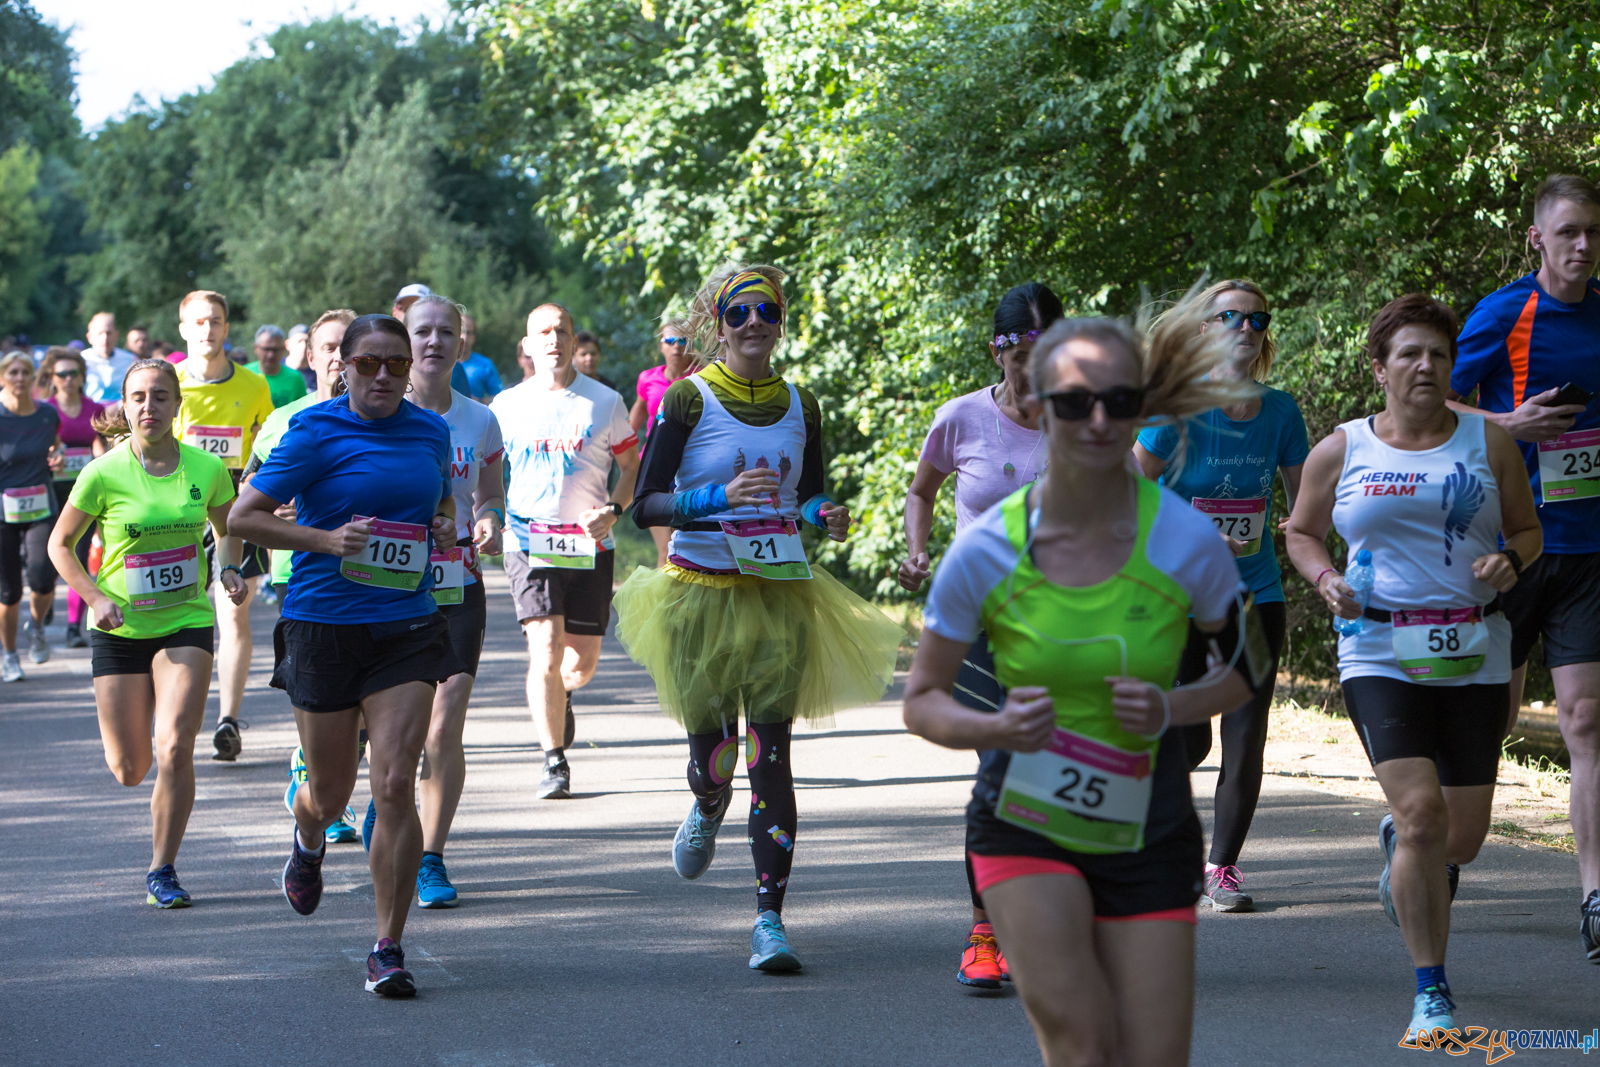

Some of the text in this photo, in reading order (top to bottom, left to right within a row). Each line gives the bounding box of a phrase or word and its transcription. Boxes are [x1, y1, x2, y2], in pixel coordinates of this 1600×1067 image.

[530, 423, 594, 438] ERNIK
[200, 438, 229, 454] 120
[533, 438, 583, 453] TEAM
[1206, 454, 1244, 467] Krosinko
[1246, 453, 1266, 467] biega
[1359, 471, 1429, 484] HERNIK
[1363, 484, 1416, 497] TEAM
[18, 498, 35, 510] 27
[143, 523, 172, 532] BIEGNIJ
[546, 536, 577, 552] 141
[749, 537, 778, 559] 21
[369, 539, 412, 566] 105
[145, 565, 184, 589] 159
[1428, 627, 1460, 653] 58
[1054, 766, 1109, 809] 25
